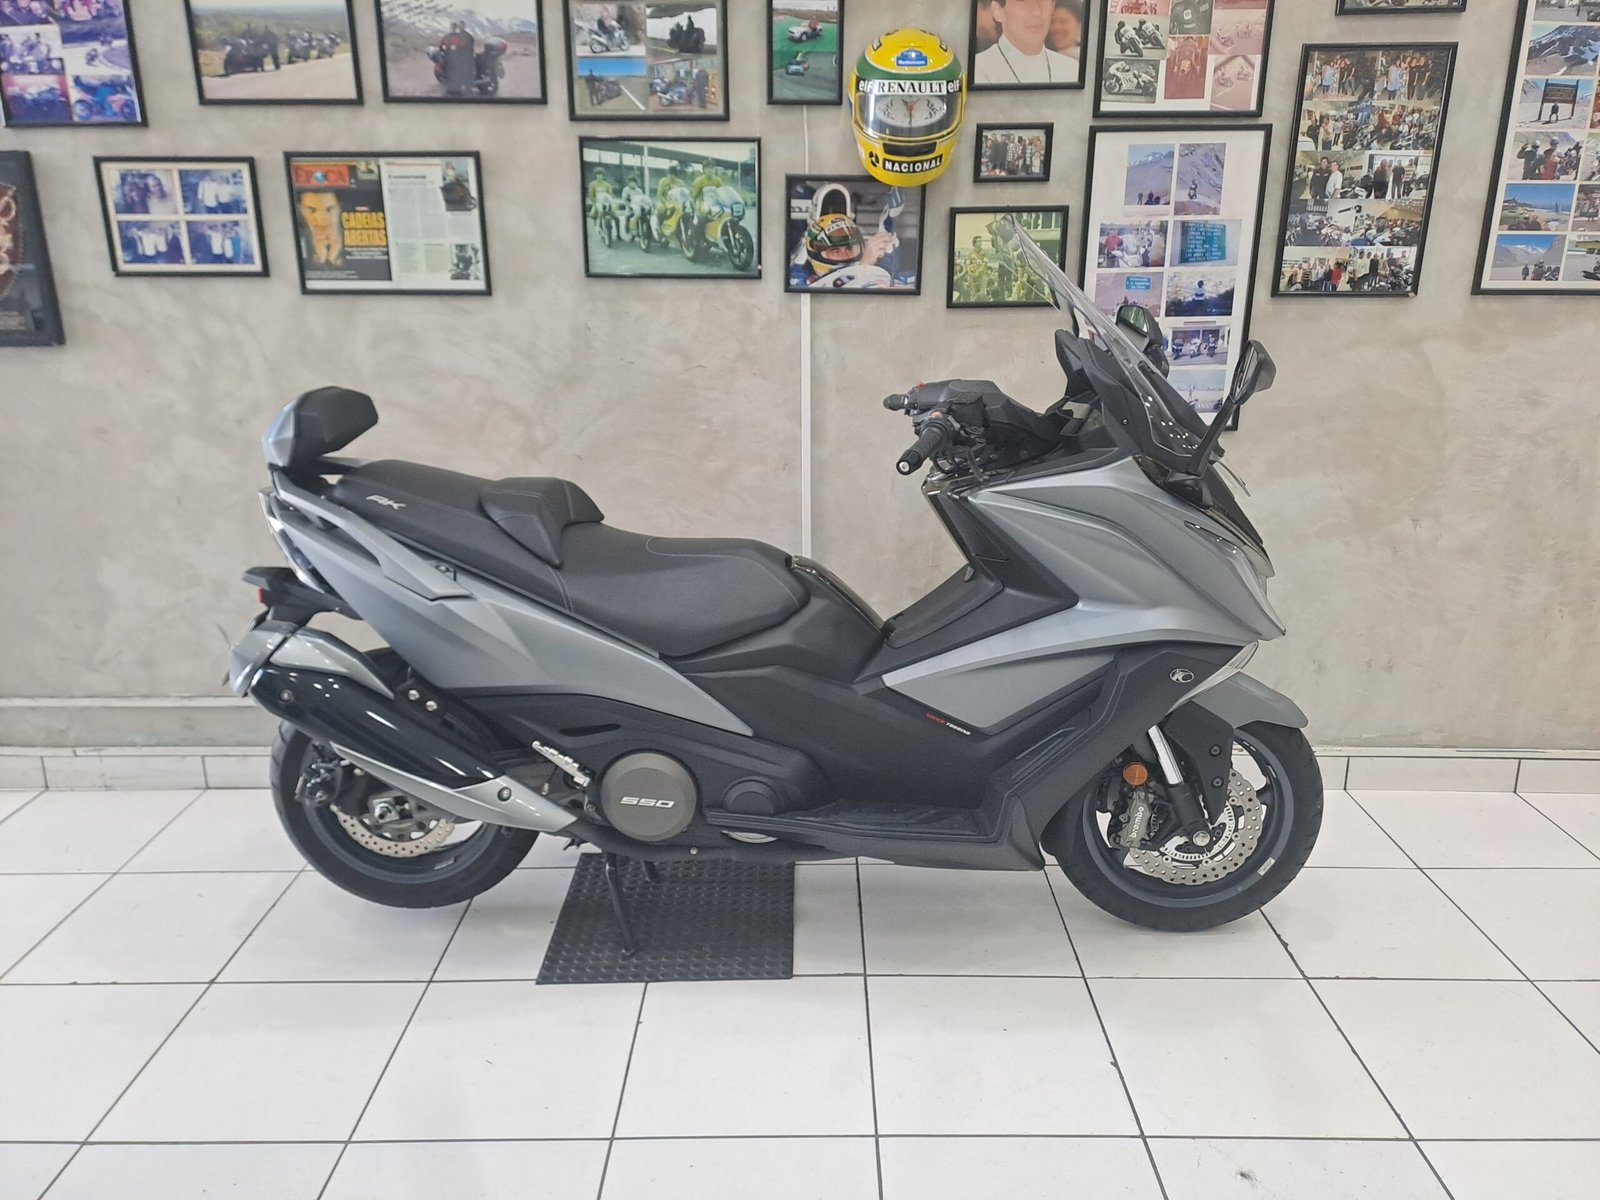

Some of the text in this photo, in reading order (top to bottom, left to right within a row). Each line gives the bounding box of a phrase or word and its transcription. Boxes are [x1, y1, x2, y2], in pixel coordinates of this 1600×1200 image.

[877, 81, 945, 93] RENAULT
[884, 158, 941, 172] NACIONAL
[341, 212, 386, 229] CADEIAS
[344, 229, 388, 247] ABERTAS
[620, 797, 675, 808] 550
[1129, 806, 1144, 838] brembo
